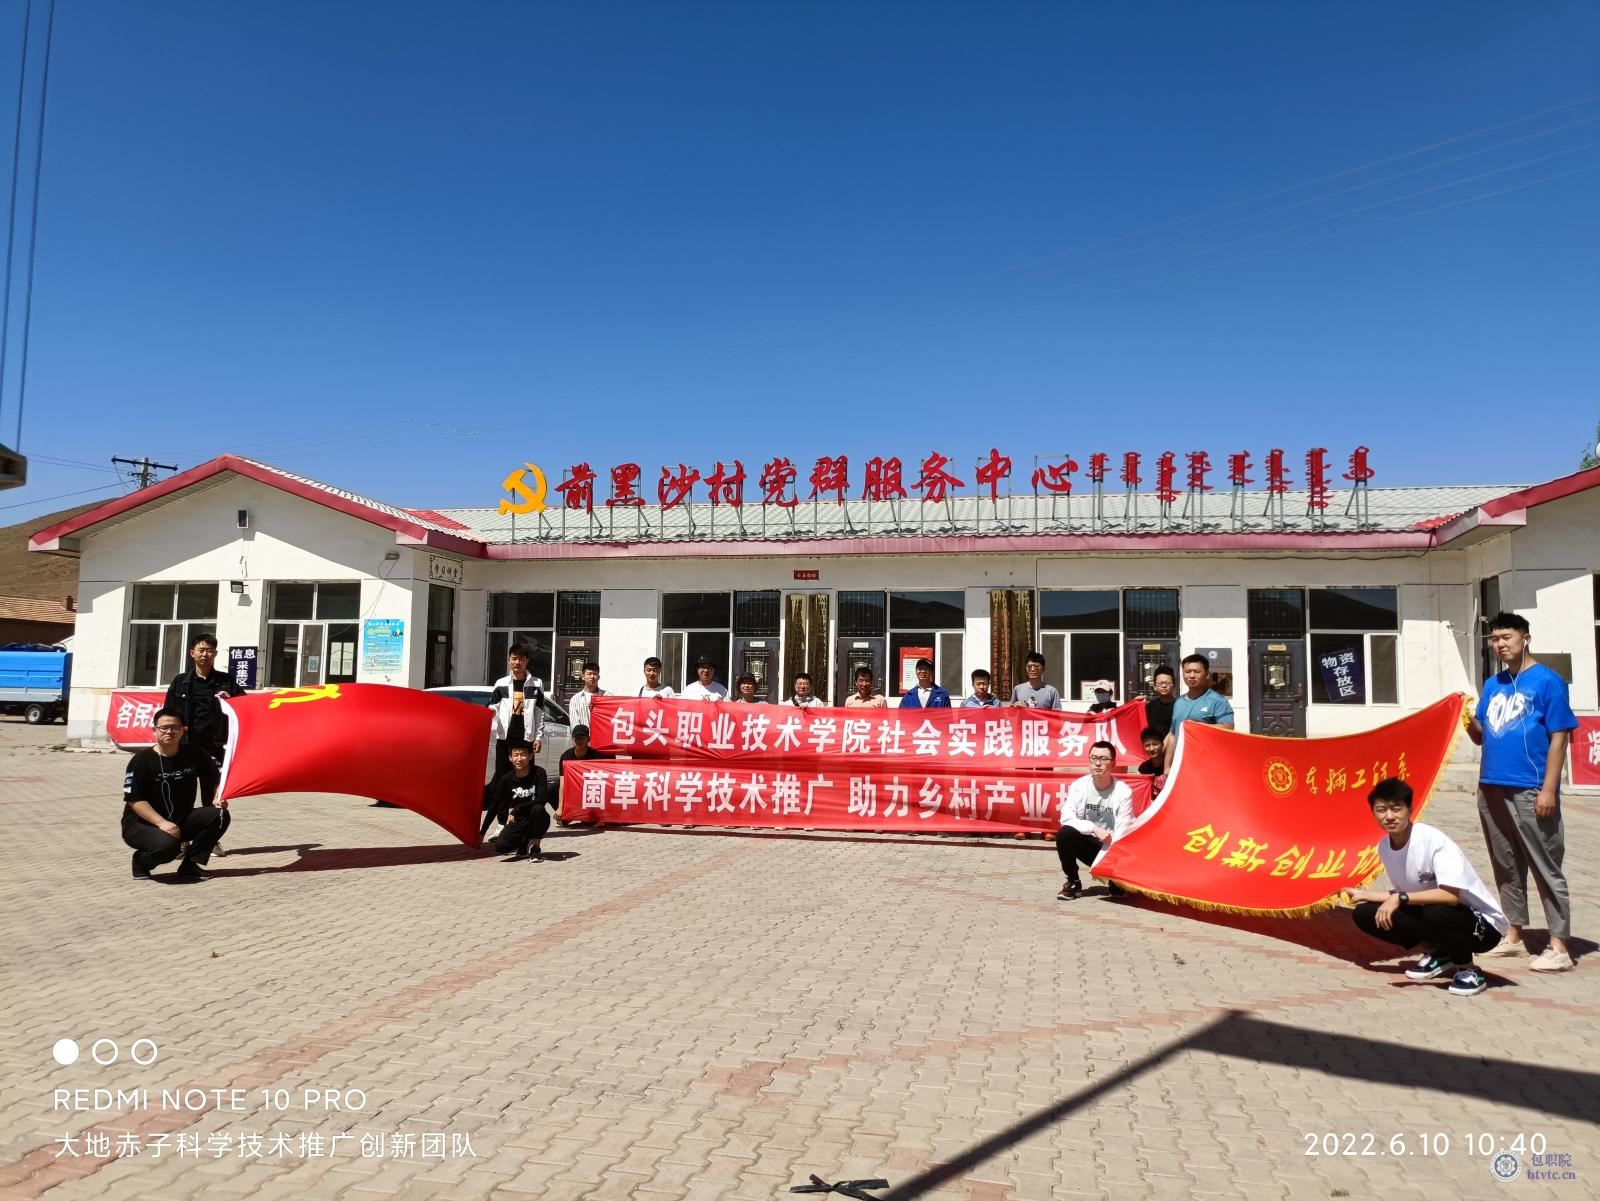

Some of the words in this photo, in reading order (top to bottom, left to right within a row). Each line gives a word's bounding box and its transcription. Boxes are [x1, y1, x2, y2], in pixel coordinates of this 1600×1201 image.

[554, 448, 1079, 514] 前黑沙村党群服务中心
[231, 649, 256, 659] 信息
[236, 661, 249, 687] 采集区
[610, 707, 1127, 757] 包头职业技术学院社会实践服务队
[581, 770, 833, 816] 菌草科学技术推广
